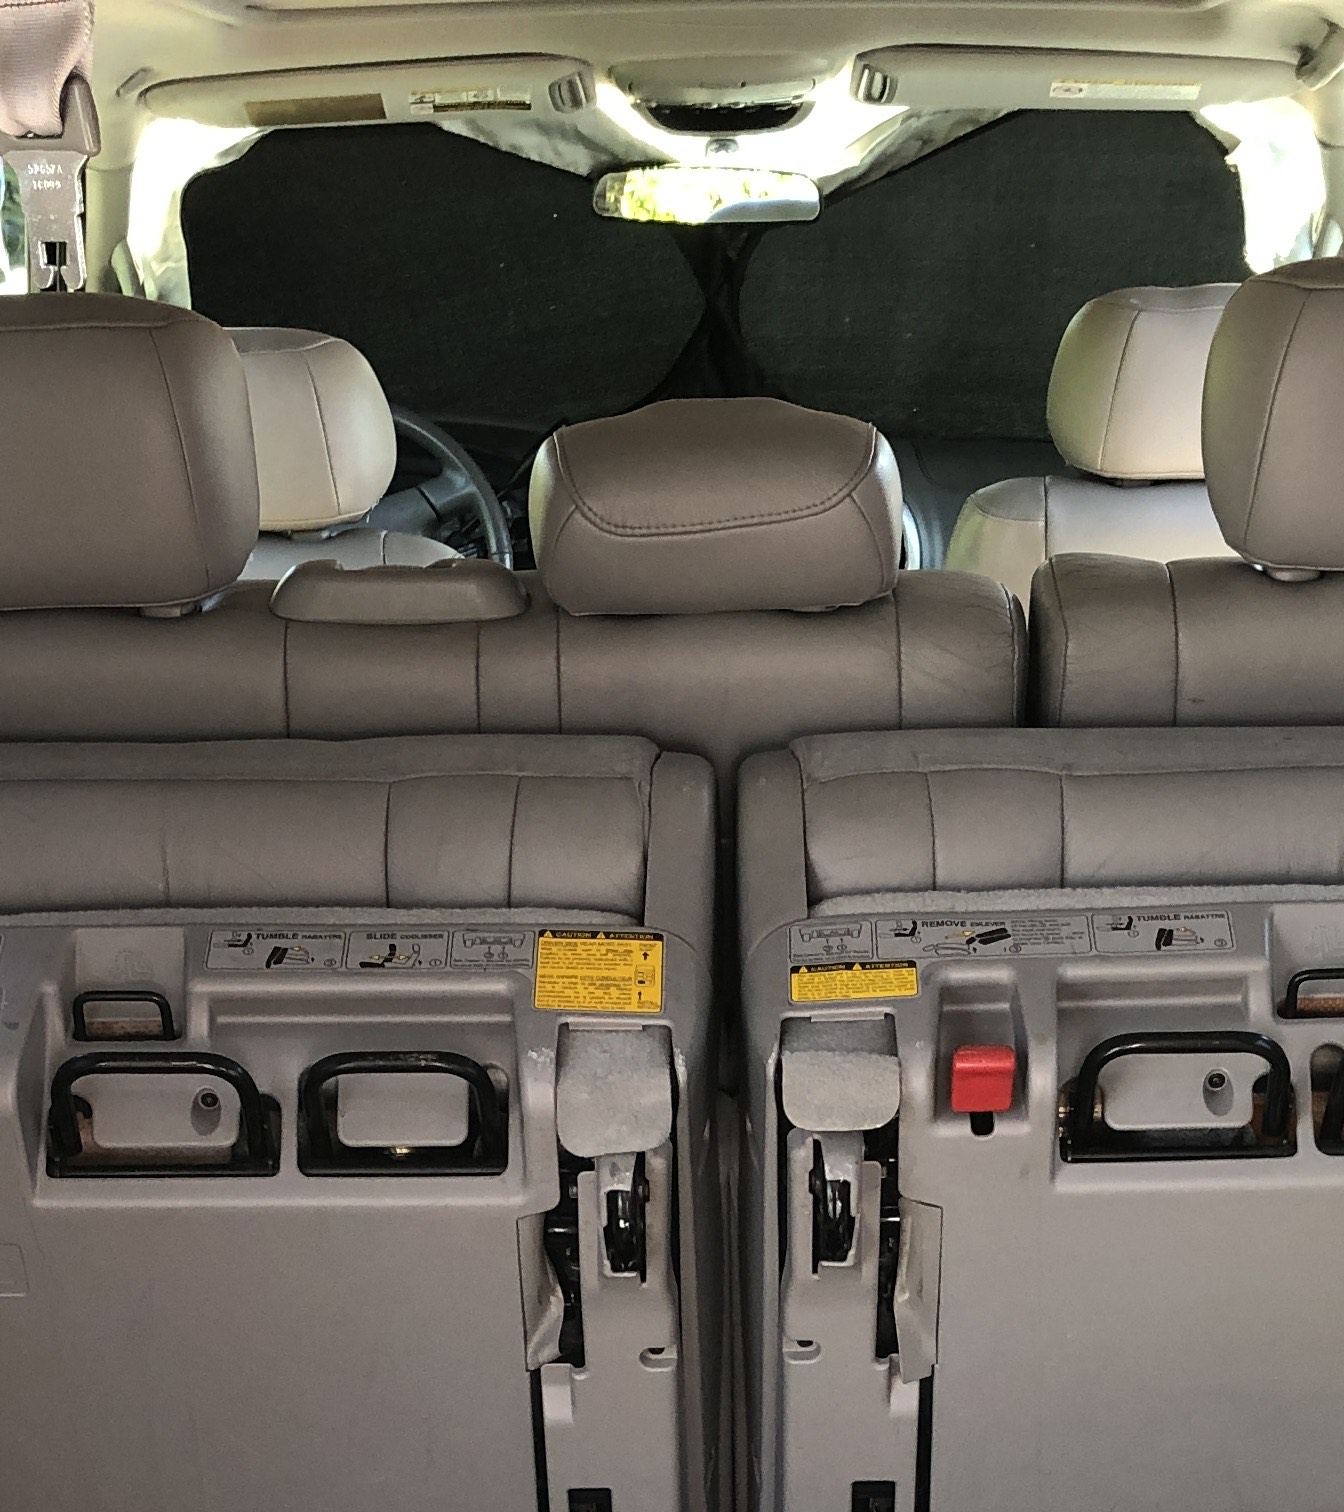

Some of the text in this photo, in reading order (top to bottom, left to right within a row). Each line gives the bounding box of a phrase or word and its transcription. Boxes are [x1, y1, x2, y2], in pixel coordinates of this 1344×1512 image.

[921, 920, 967, 928] REMOVE
[255, 932, 299, 940] TUMBLE
[366, 932, 397, 940] SLIDE
[609, 932, 654, 940] ATTENTION
